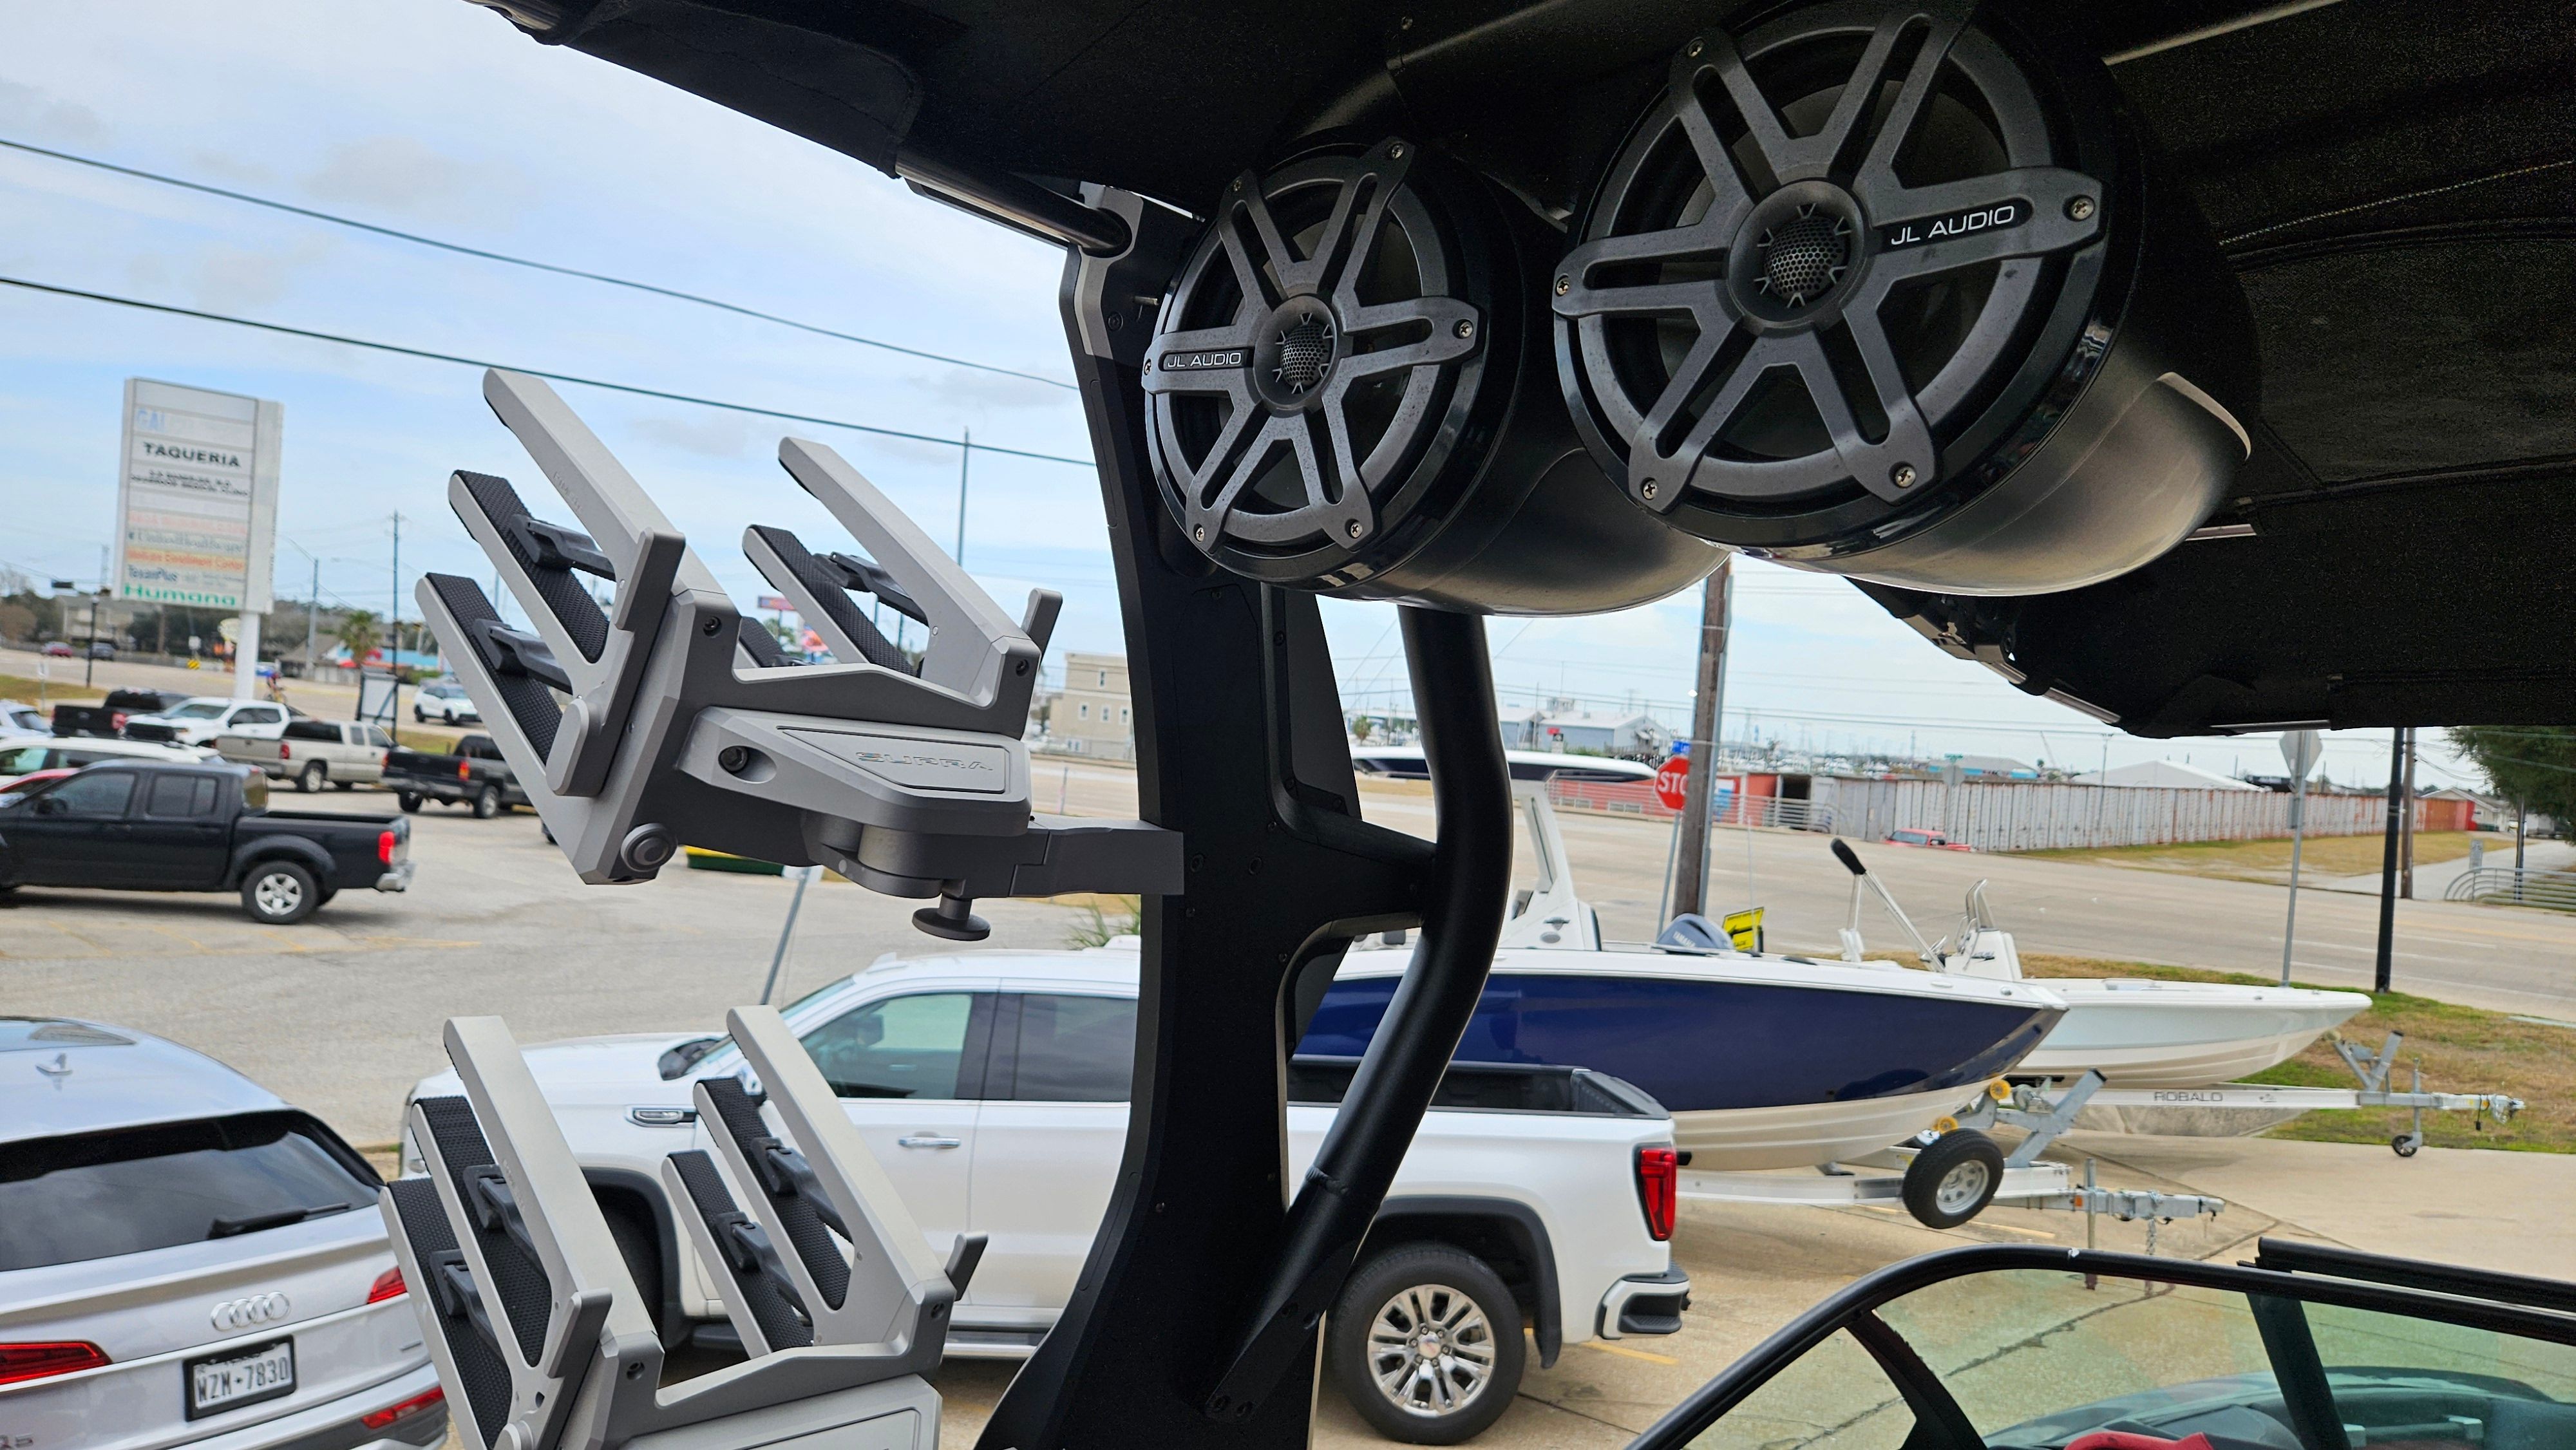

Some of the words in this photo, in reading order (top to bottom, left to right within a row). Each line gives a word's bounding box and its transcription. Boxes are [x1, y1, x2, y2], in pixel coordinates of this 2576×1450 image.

[1891, 226, 1920, 245] JL
[1928, 205, 2015, 238] AUDIO
[1167, 355, 1186, 368] JL
[1190, 352, 1242, 366] AUDIO
[144, 442, 241, 467] TAQUERIA
[124, 583, 236, 607] Humana
[1658, 771, 1689, 796] STO
